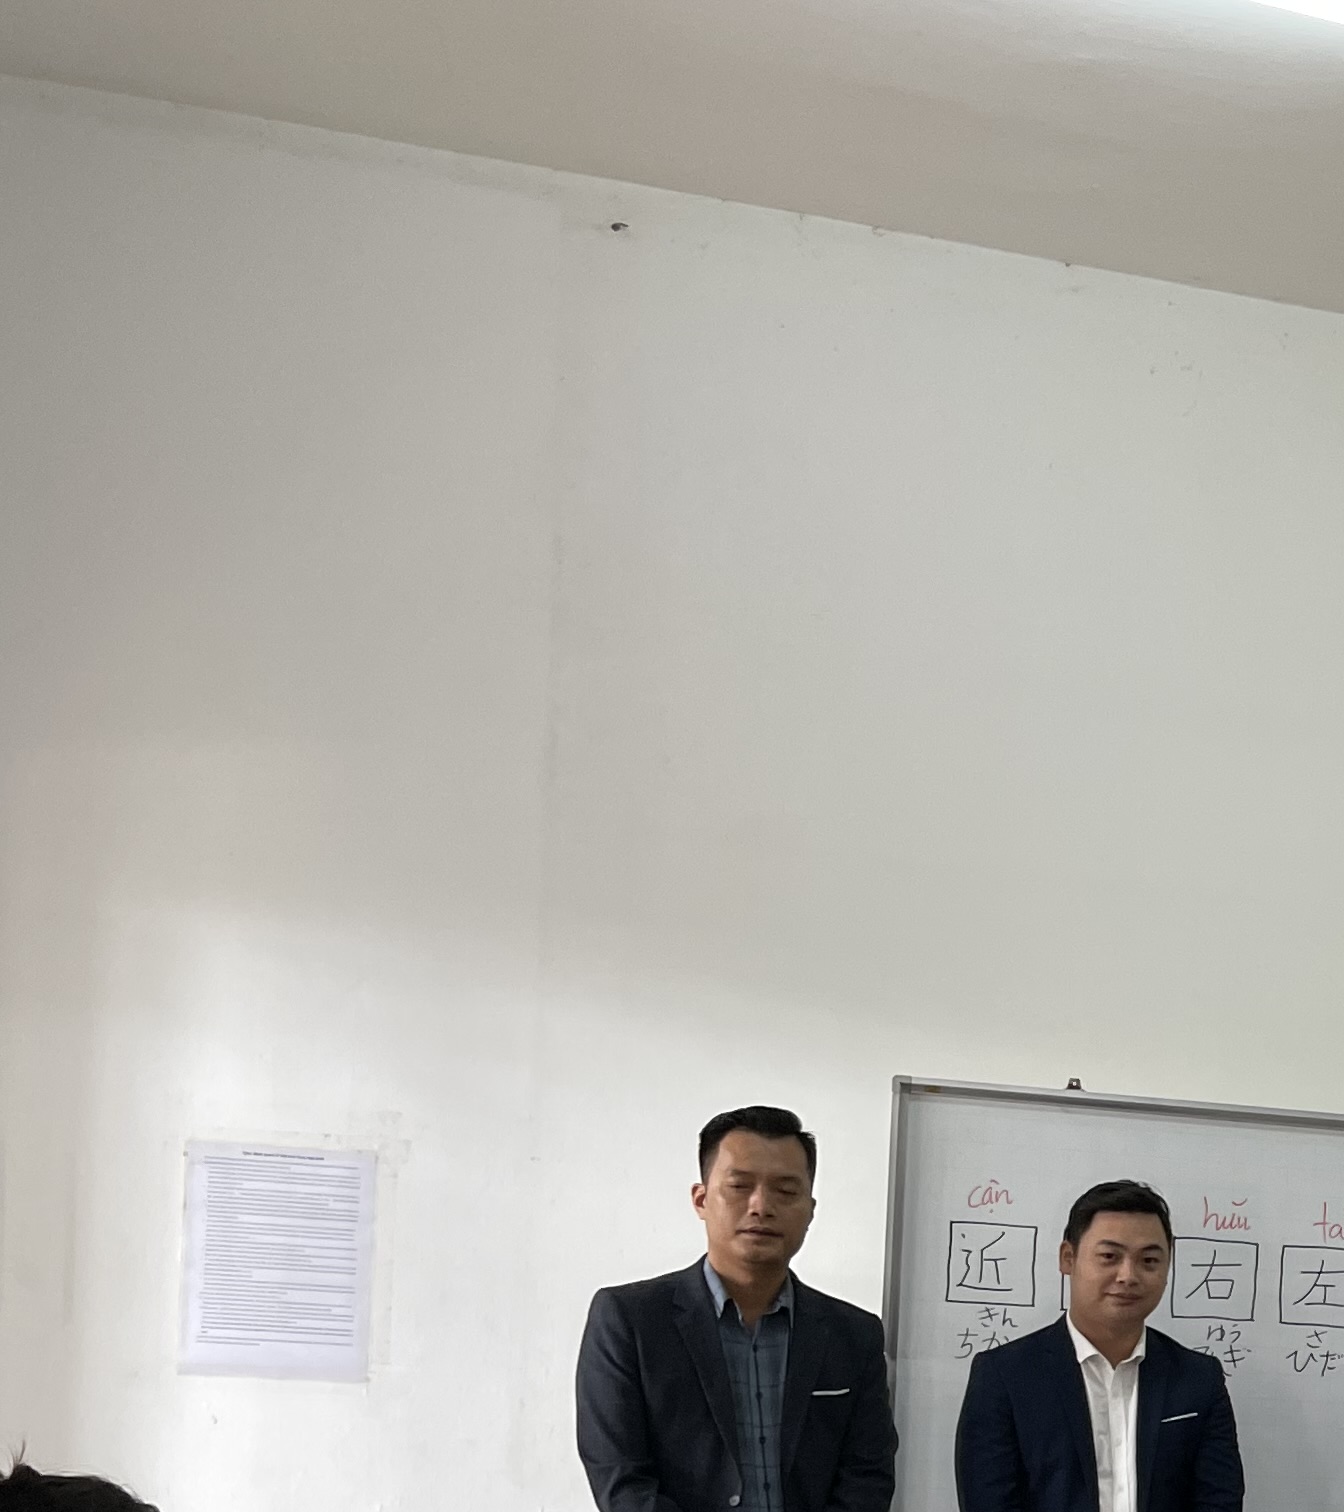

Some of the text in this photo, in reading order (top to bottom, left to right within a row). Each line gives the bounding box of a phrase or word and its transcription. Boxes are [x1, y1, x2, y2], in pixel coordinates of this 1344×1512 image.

[956, 1231, 1014, 1292] 近
[1185, 1249, 1243, 1299] 右
[978, 1306, 1019, 1328] きん
